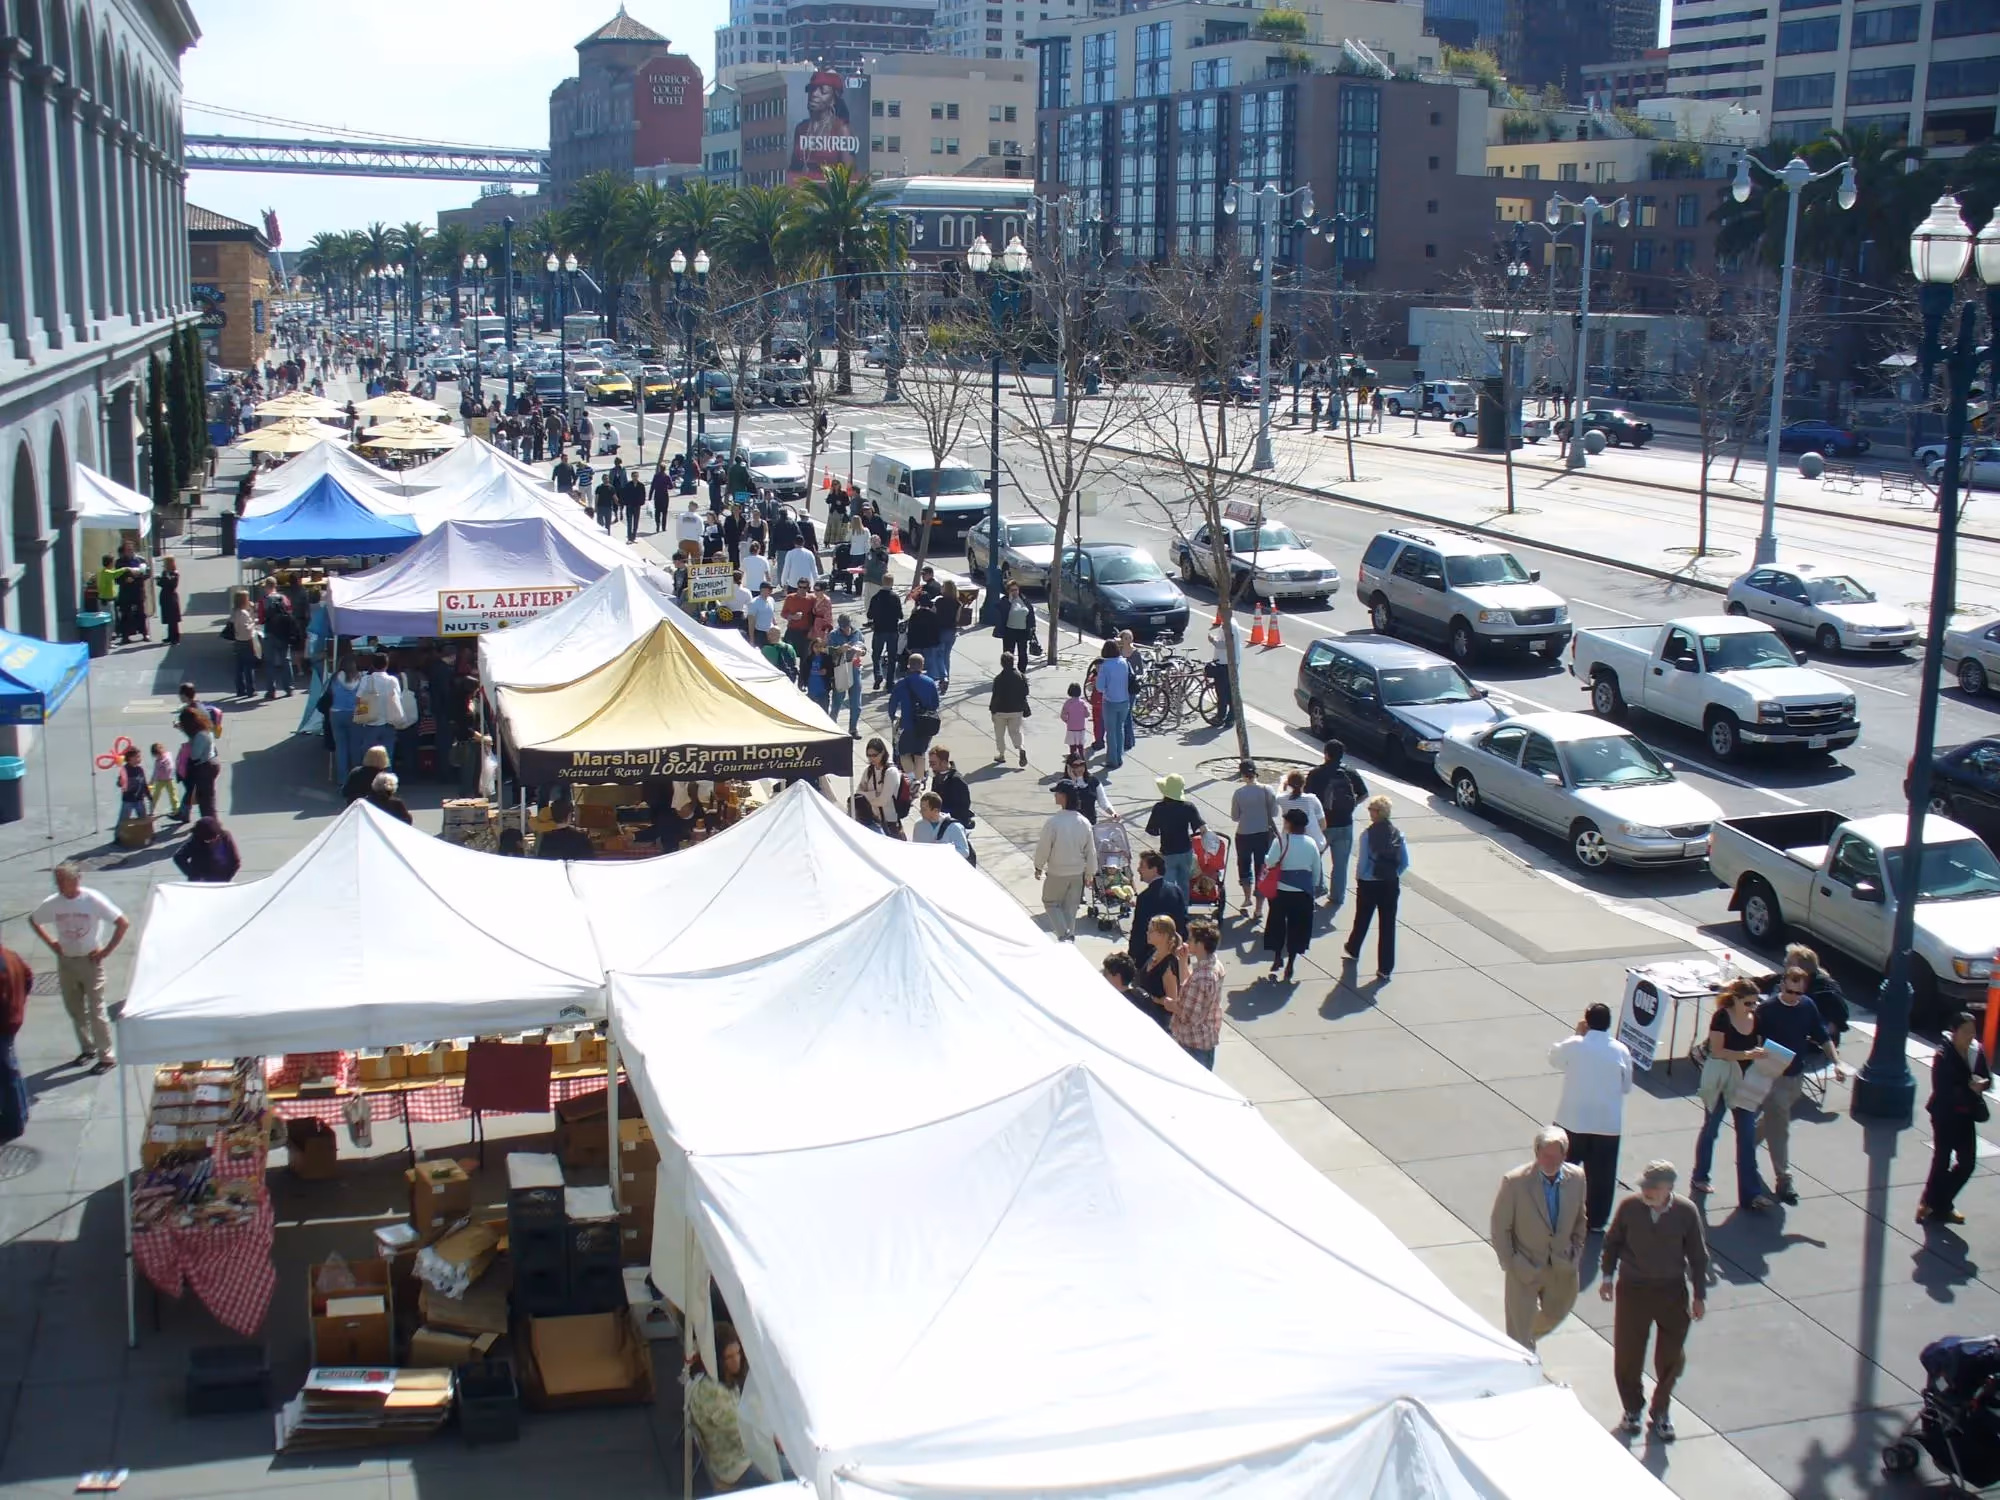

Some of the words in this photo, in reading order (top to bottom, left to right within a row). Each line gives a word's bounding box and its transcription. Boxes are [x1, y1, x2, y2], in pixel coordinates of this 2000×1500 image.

[649, 74, 690, 84] HARBOR
[653, 85, 684, 95] COURT
[653, 95, 683, 105] HOTEL
[800, 135, 860, 154] DESI(RED)
[693, 580, 723, 590] PREMIUM
[445, 594, 485, 610] G.L.
[481, 610, 538, 619] PREMIUM
[444, 622, 490, 632] NUTS
[573, 748, 680, 766] Marshall's
[686, 747, 737, 762] Farm
[743, 745, 807, 760] Honey
[558, 766, 611, 777] Natural
[614, 767, 643, 777] Raw
[650, 762, 707, 775] LOCAL
[713, 762, 765, 775] Gourmet
[767, 757, 823, 769] Varietals
[1635, 989, 1656, 1015] ONE
